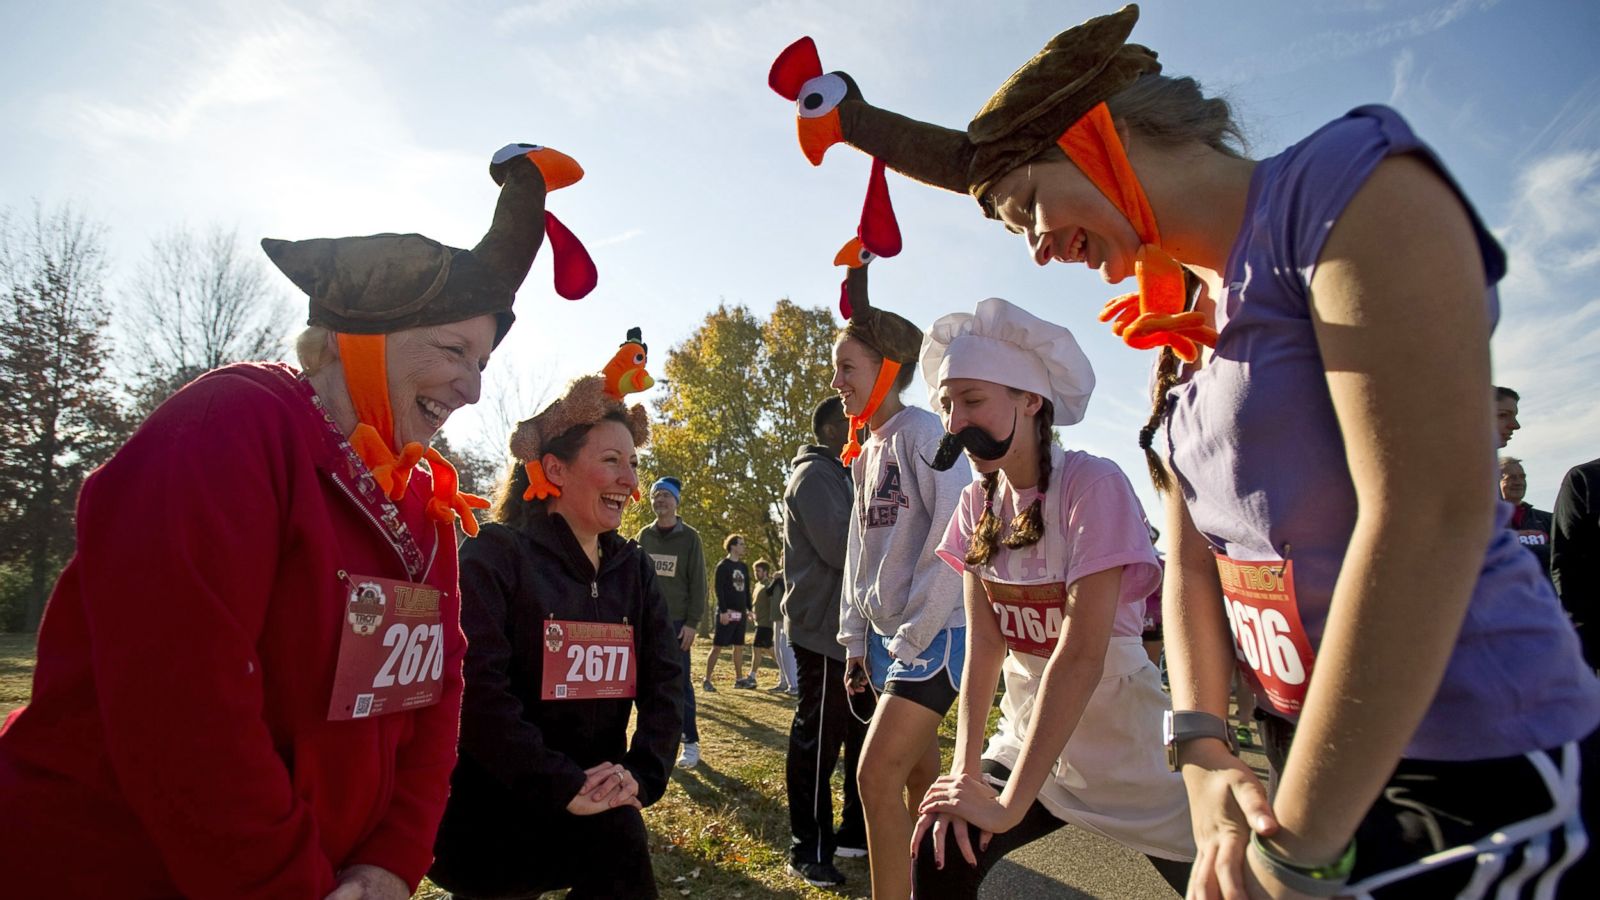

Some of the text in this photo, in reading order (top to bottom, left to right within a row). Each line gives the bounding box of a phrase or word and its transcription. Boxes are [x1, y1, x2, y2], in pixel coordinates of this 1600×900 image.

[871, 462, 909, 508] A
[862, 505, 899, 529] LES
[654, 560, 675, 572] 052
[993, 602, 1064, 643] 2764
[372, 623, 444, 688] 2678
[566, 644, 630, 682] 2677
